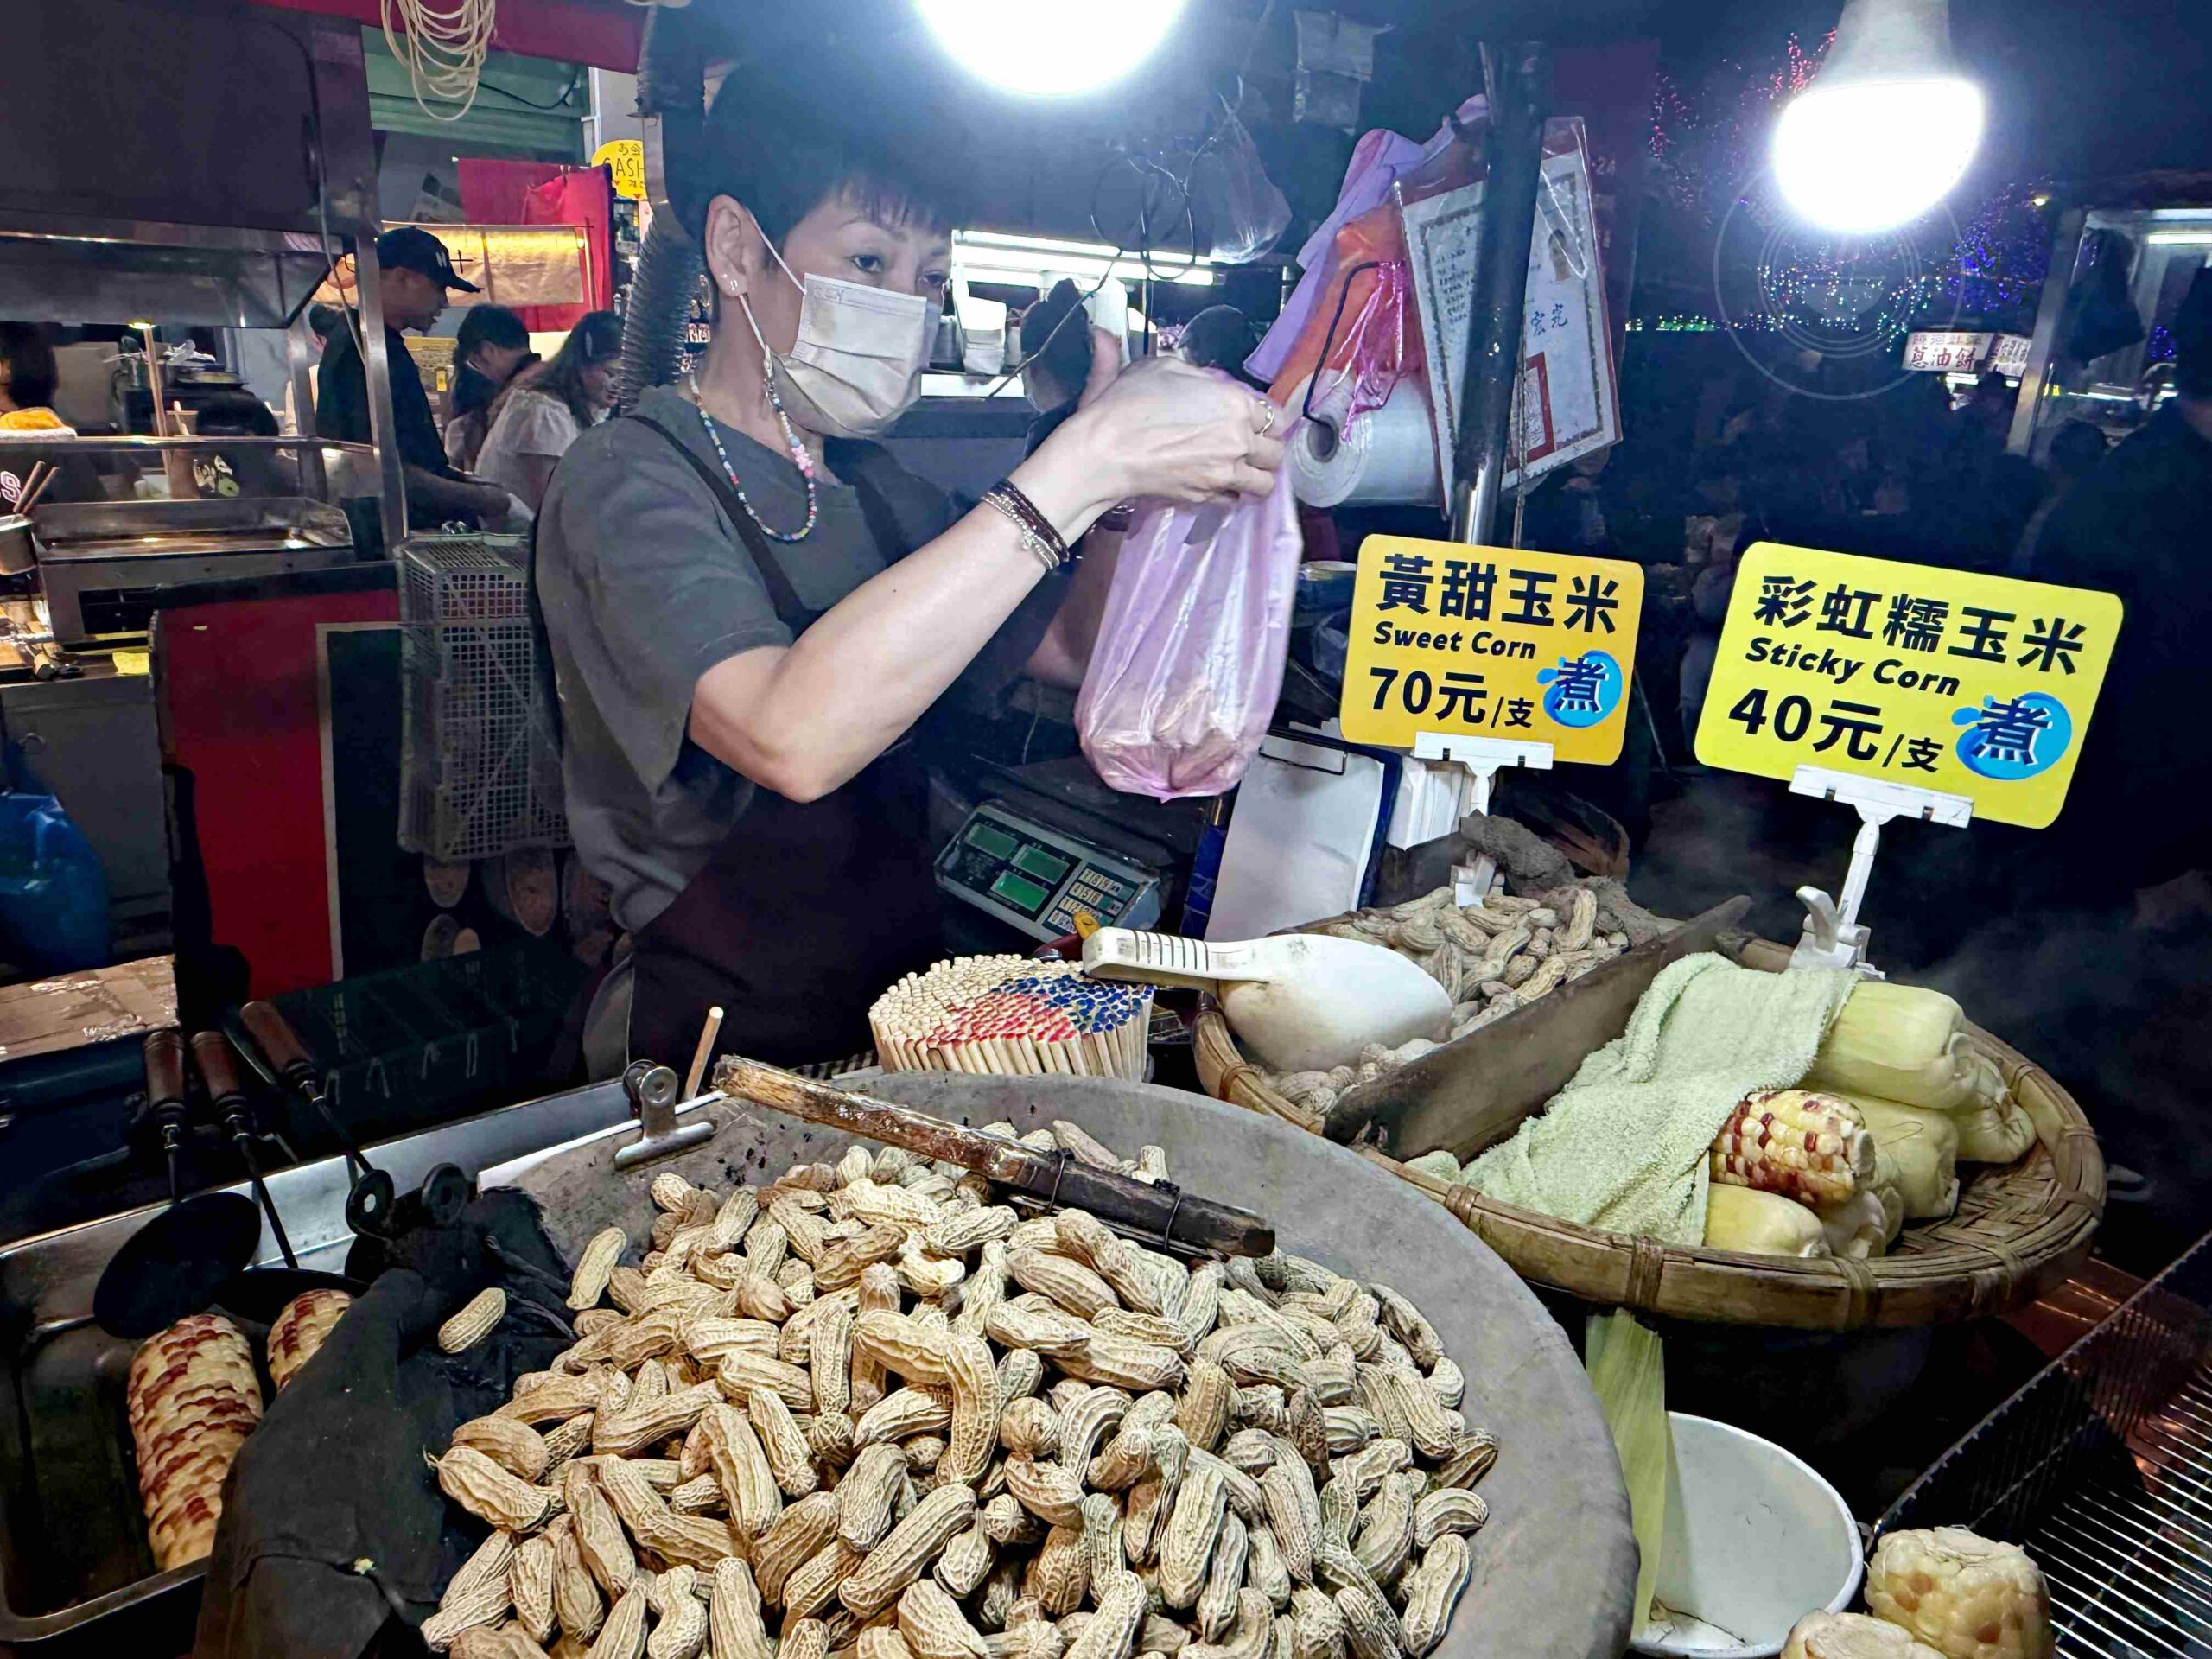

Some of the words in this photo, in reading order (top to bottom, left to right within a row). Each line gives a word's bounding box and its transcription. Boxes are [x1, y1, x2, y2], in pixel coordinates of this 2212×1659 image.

[1373, 621, 1463, 652] Sweet
[1471, 632, 1536, 659] Corn
[1753, 575, 2087, 675] 彩虹糯玉米
[1554, 658, 1609, 714] 煮
[1745, 637, 1864, 685] Sticky
[1873, 658, 1960, 696] Corn
[1971, 699, 2051, 766] 煮
